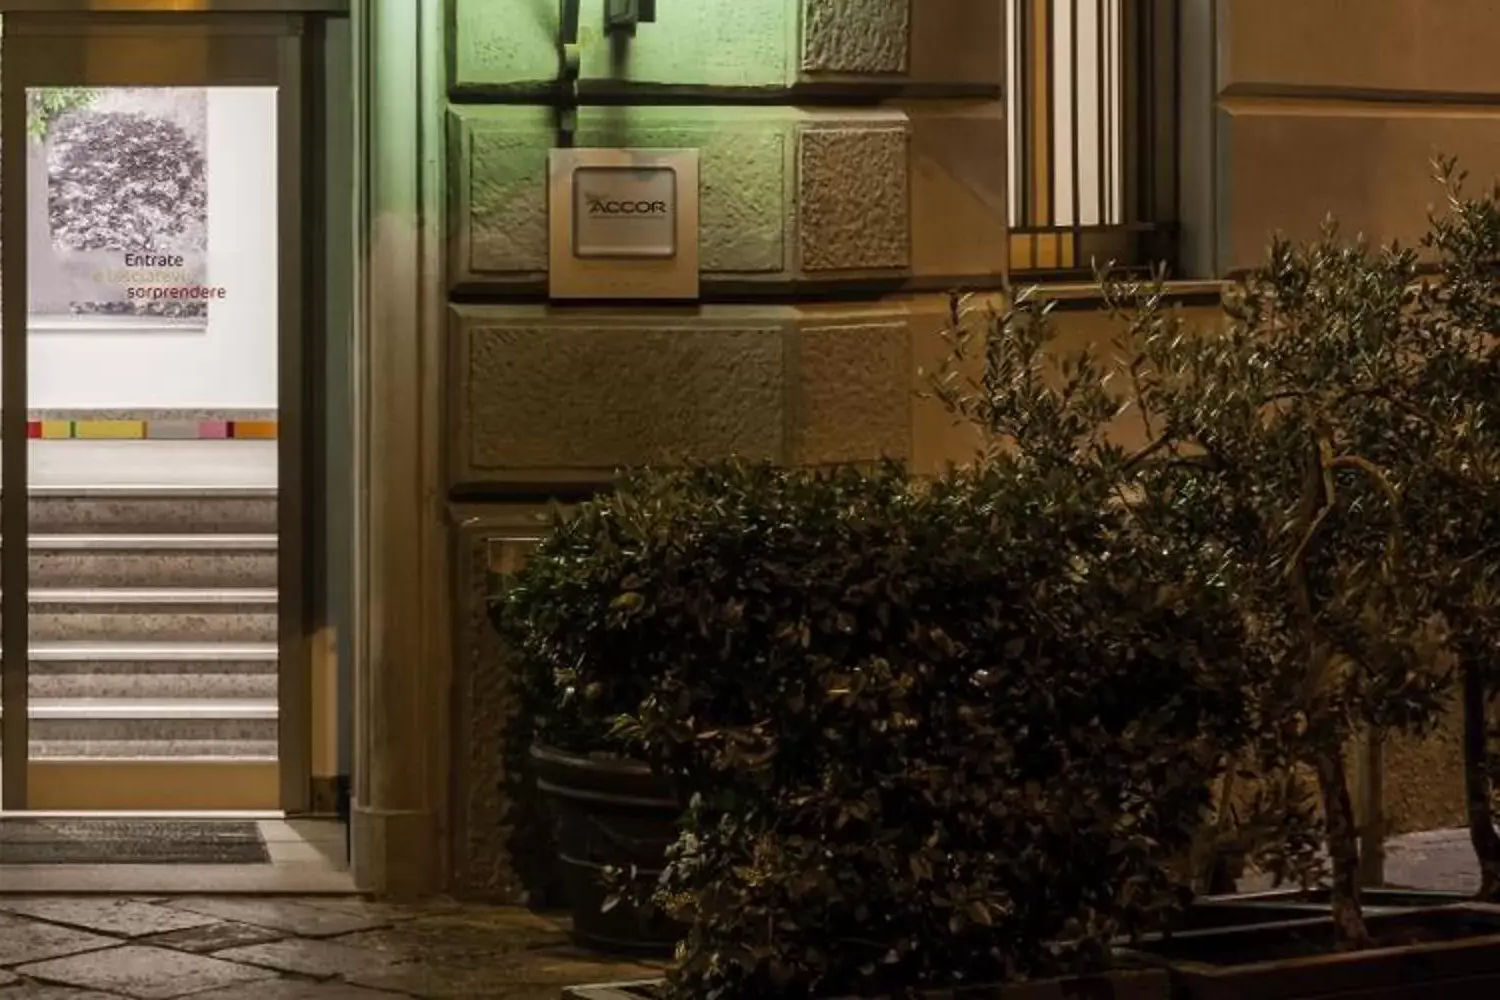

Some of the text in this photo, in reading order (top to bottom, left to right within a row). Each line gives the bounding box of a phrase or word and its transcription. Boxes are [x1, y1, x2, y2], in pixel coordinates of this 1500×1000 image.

[589, 200, 667, 214] ACCOR
[125, 253, 184, 267] Entrate
[127, 284, 226, 299] sorprendere
